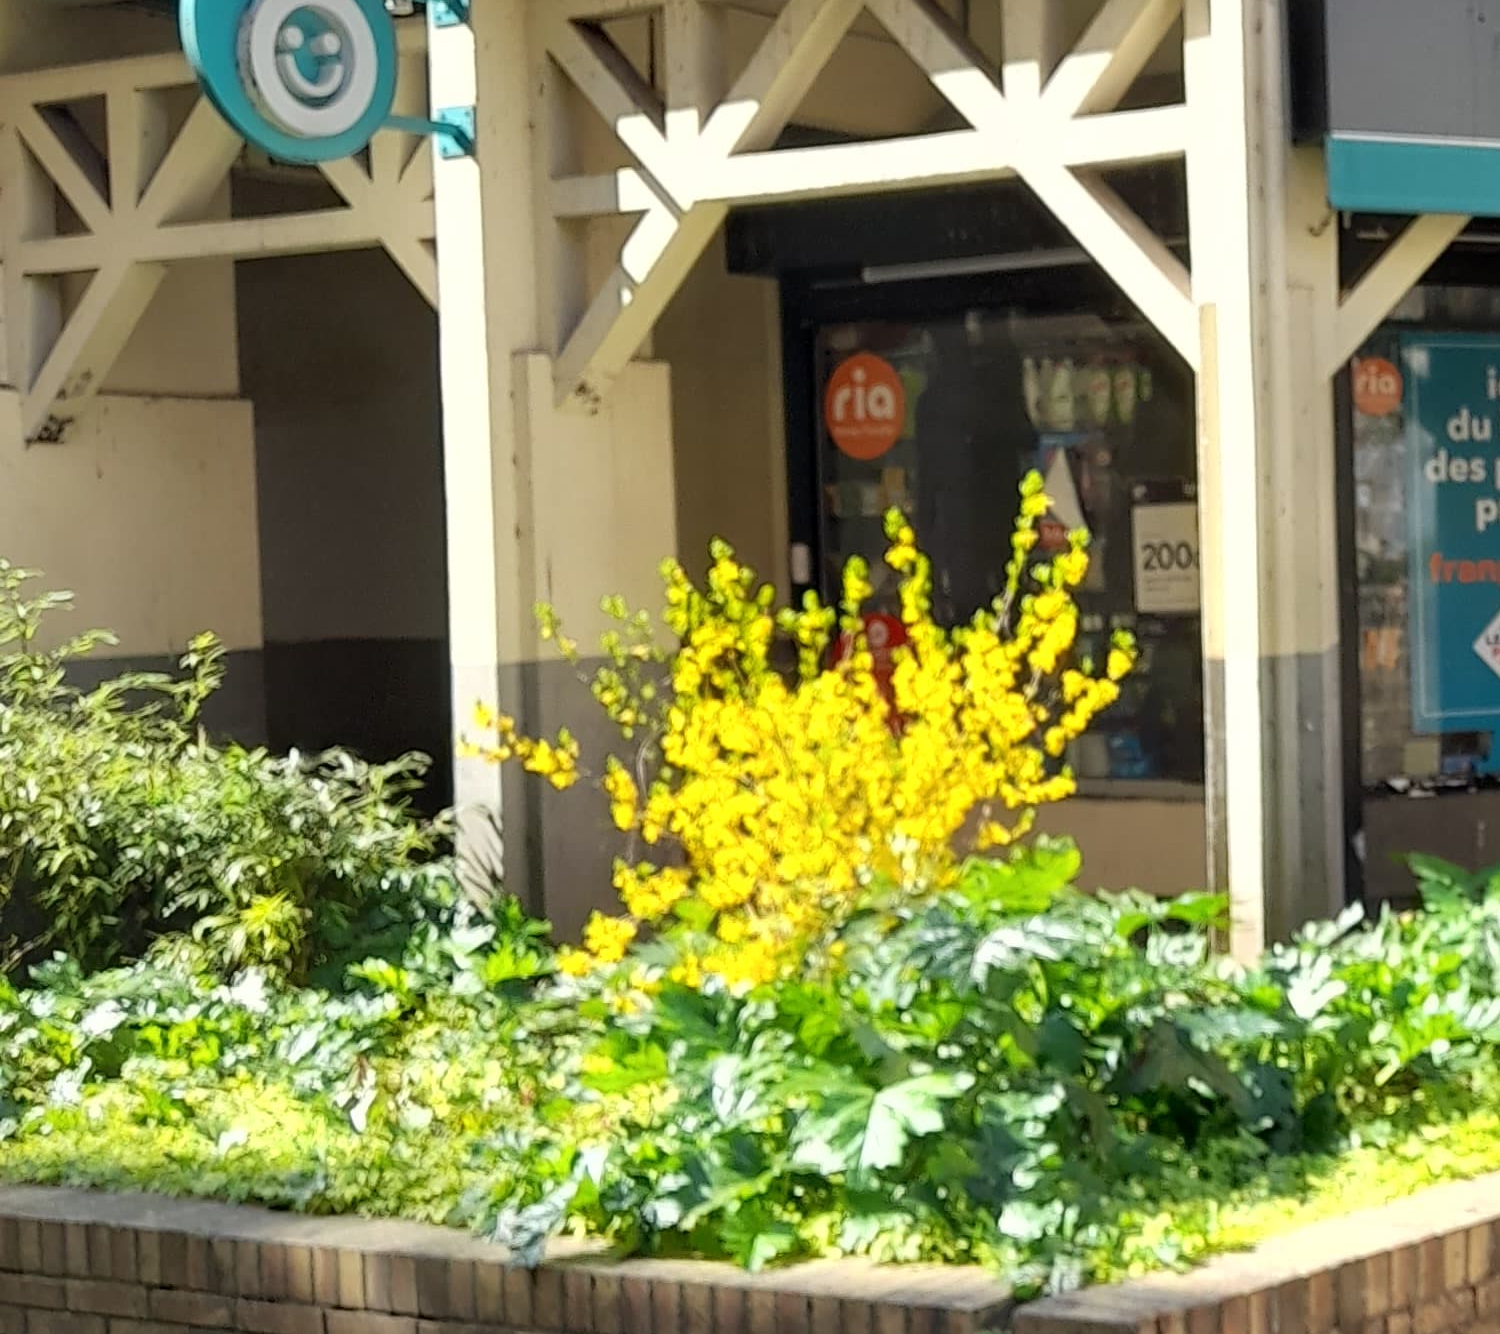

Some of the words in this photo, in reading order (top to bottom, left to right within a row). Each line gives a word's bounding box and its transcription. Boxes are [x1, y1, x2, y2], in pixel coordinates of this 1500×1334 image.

[832, 366, 896, 421] ria
[1446, 406, 1492, 442] du
[1424, 447, 1486, 482] des
